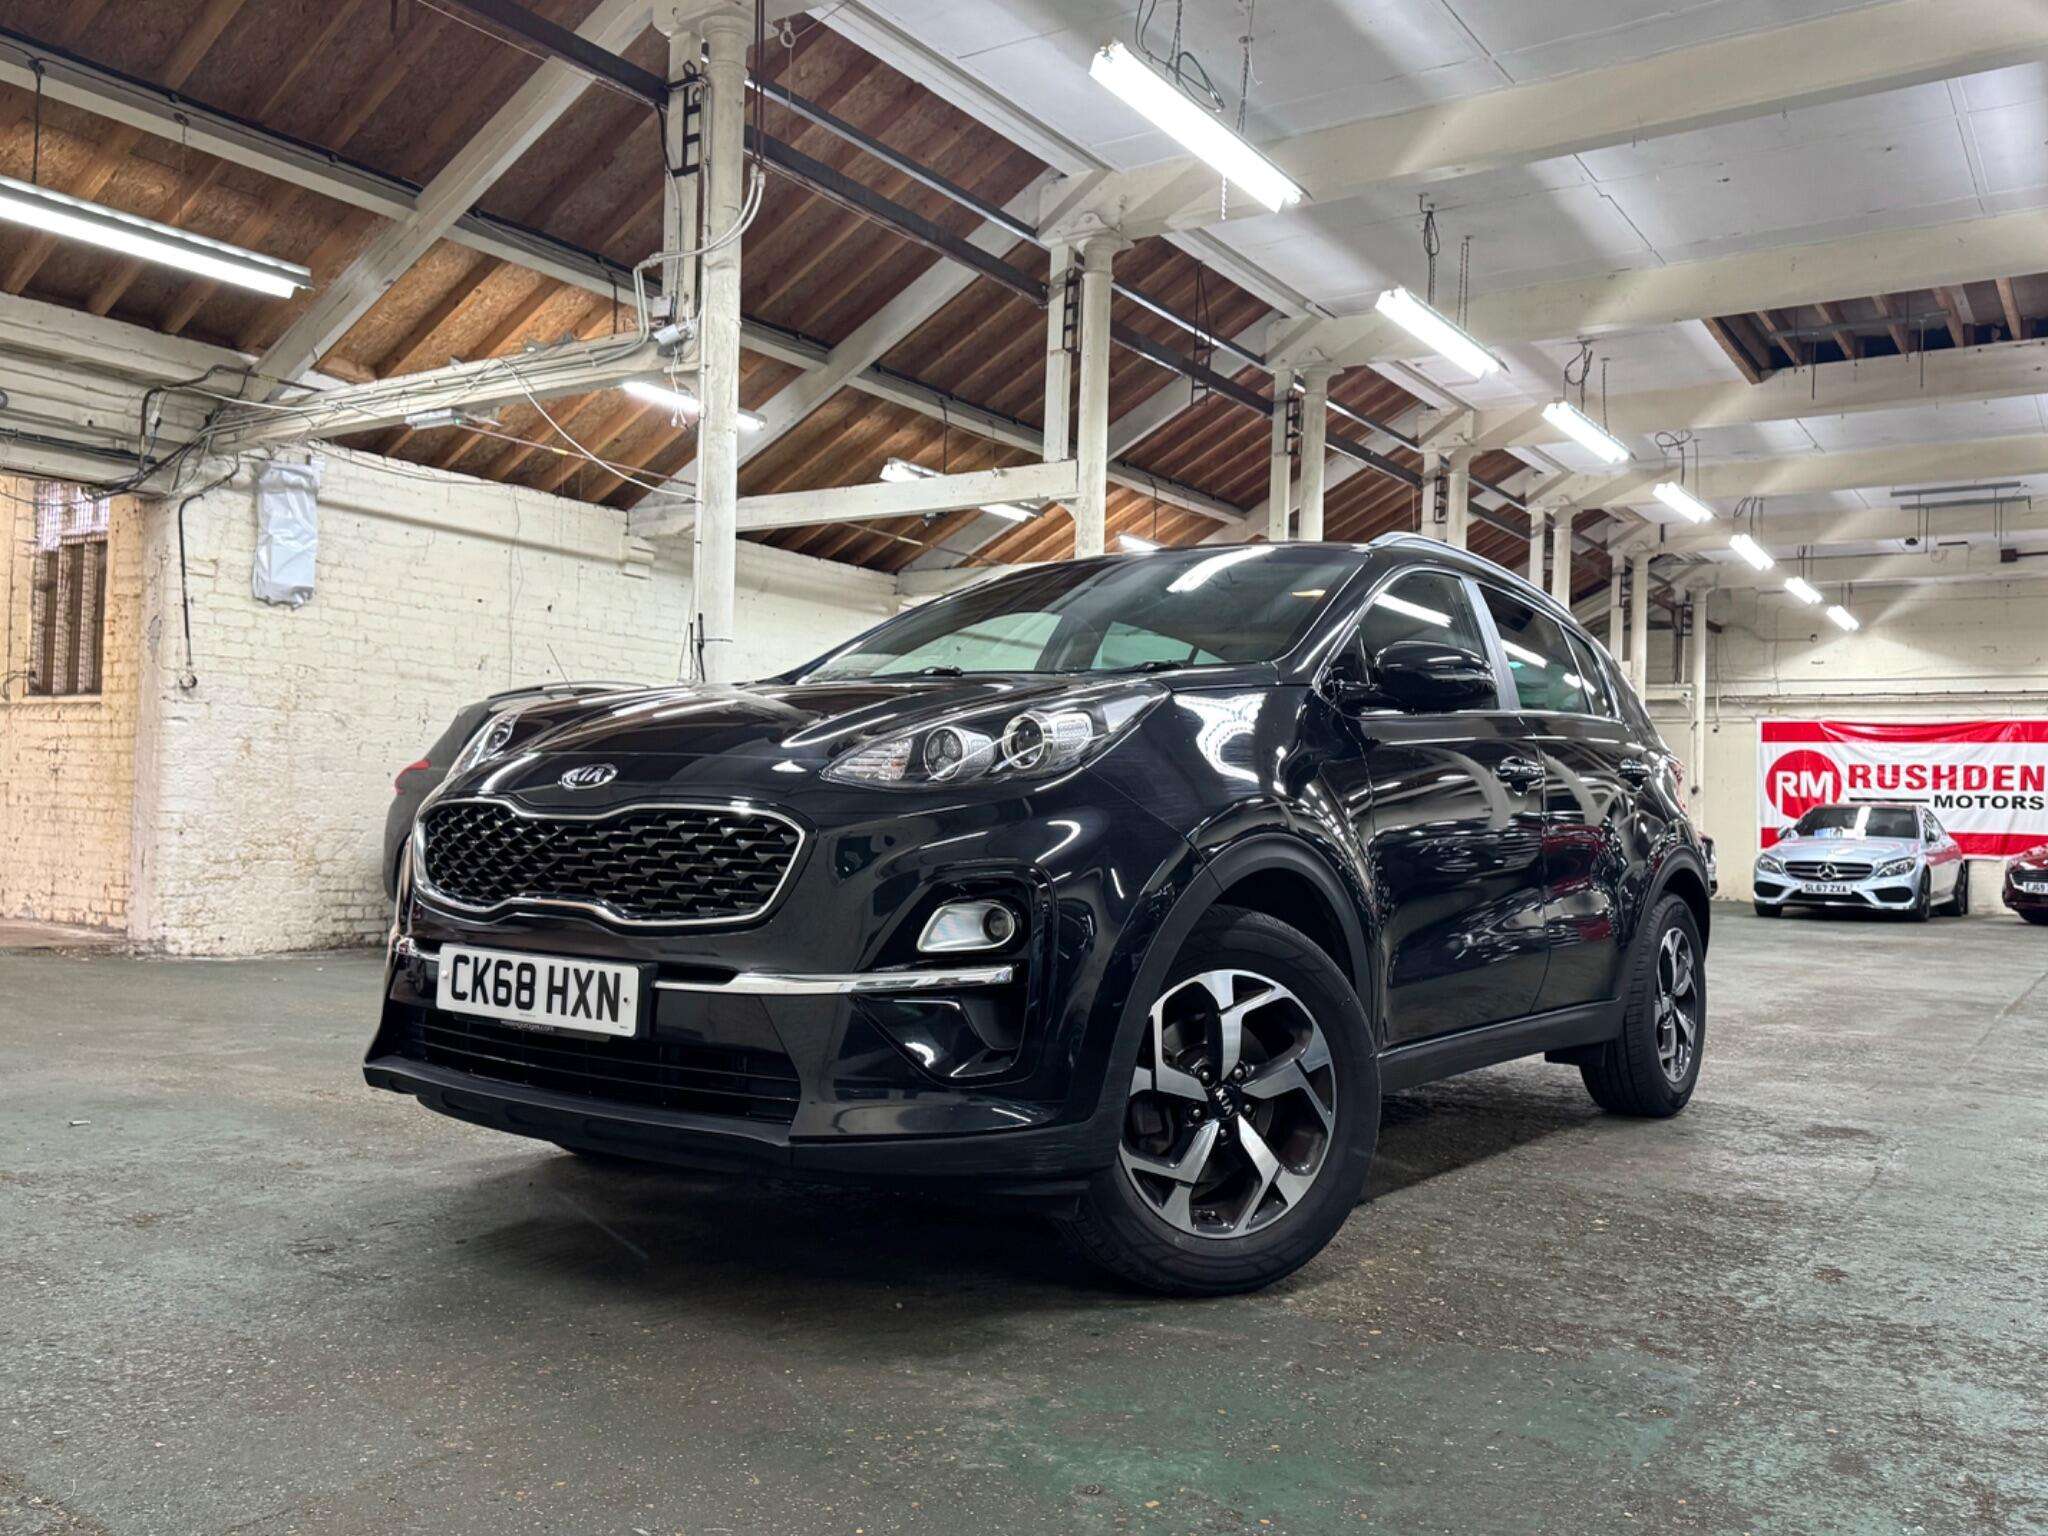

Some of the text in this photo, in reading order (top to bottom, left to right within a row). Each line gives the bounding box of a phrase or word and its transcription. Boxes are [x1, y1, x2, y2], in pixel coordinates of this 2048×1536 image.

[564, 765, 611, 788] KIA
[1776, 770, 1834, 811] RM
[1848, 764, 2045, 791] RUSHDEN
[1934, 794, 2044, 810] MOTORS
[451, 954, 622, 1022] CK68 HXN
[1215, 1087, 1233, 1116] KIA
